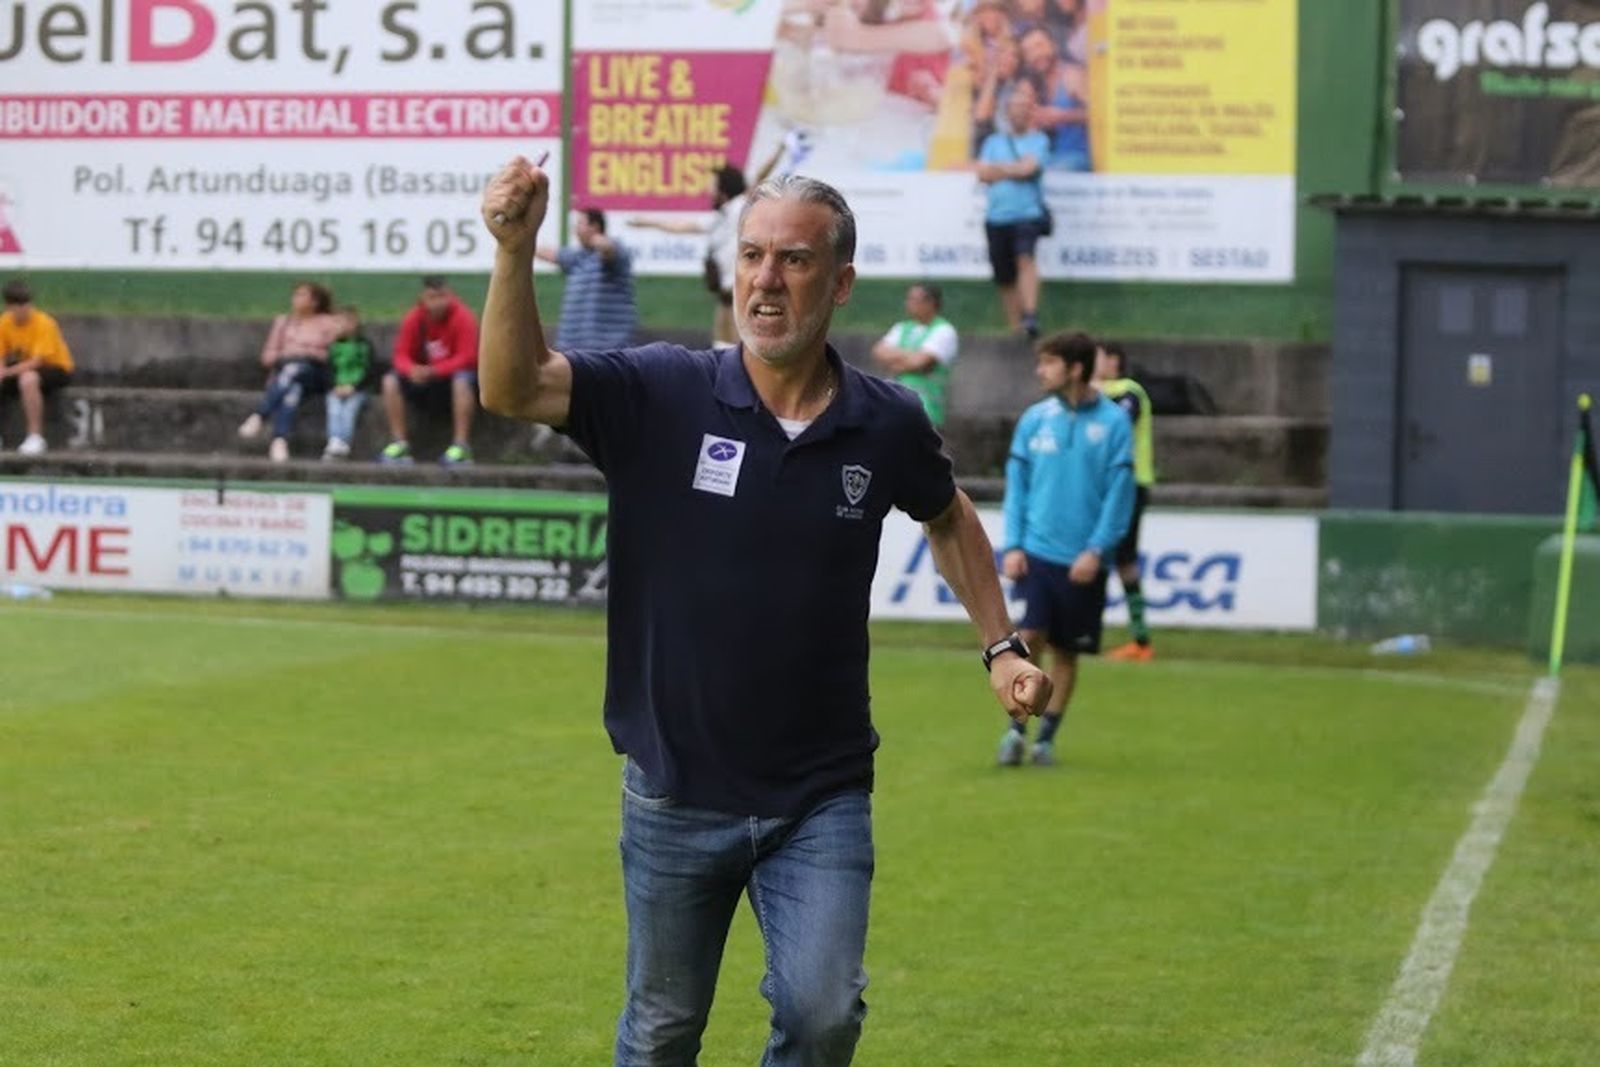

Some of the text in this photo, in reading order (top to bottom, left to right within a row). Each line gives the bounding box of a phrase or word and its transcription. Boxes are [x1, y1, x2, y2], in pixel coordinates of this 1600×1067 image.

[380, 0, 545, 63] s.a.
[589, 56, 694, 98] LIVE &
[137, 99, 182, 133] DE
[191, 99, 357, 133] MATERIAL
[366, 98, 550, 133] ELECTRICO
[588, 104, 732, 148] BREATHE
[74, 165, 134, 195] Pol.
[147, 165, 352, 202] Artunduaga
[124, 217, 478, 256] Tf. 94 405 16 05
[6, 523, 131, 575] ME
